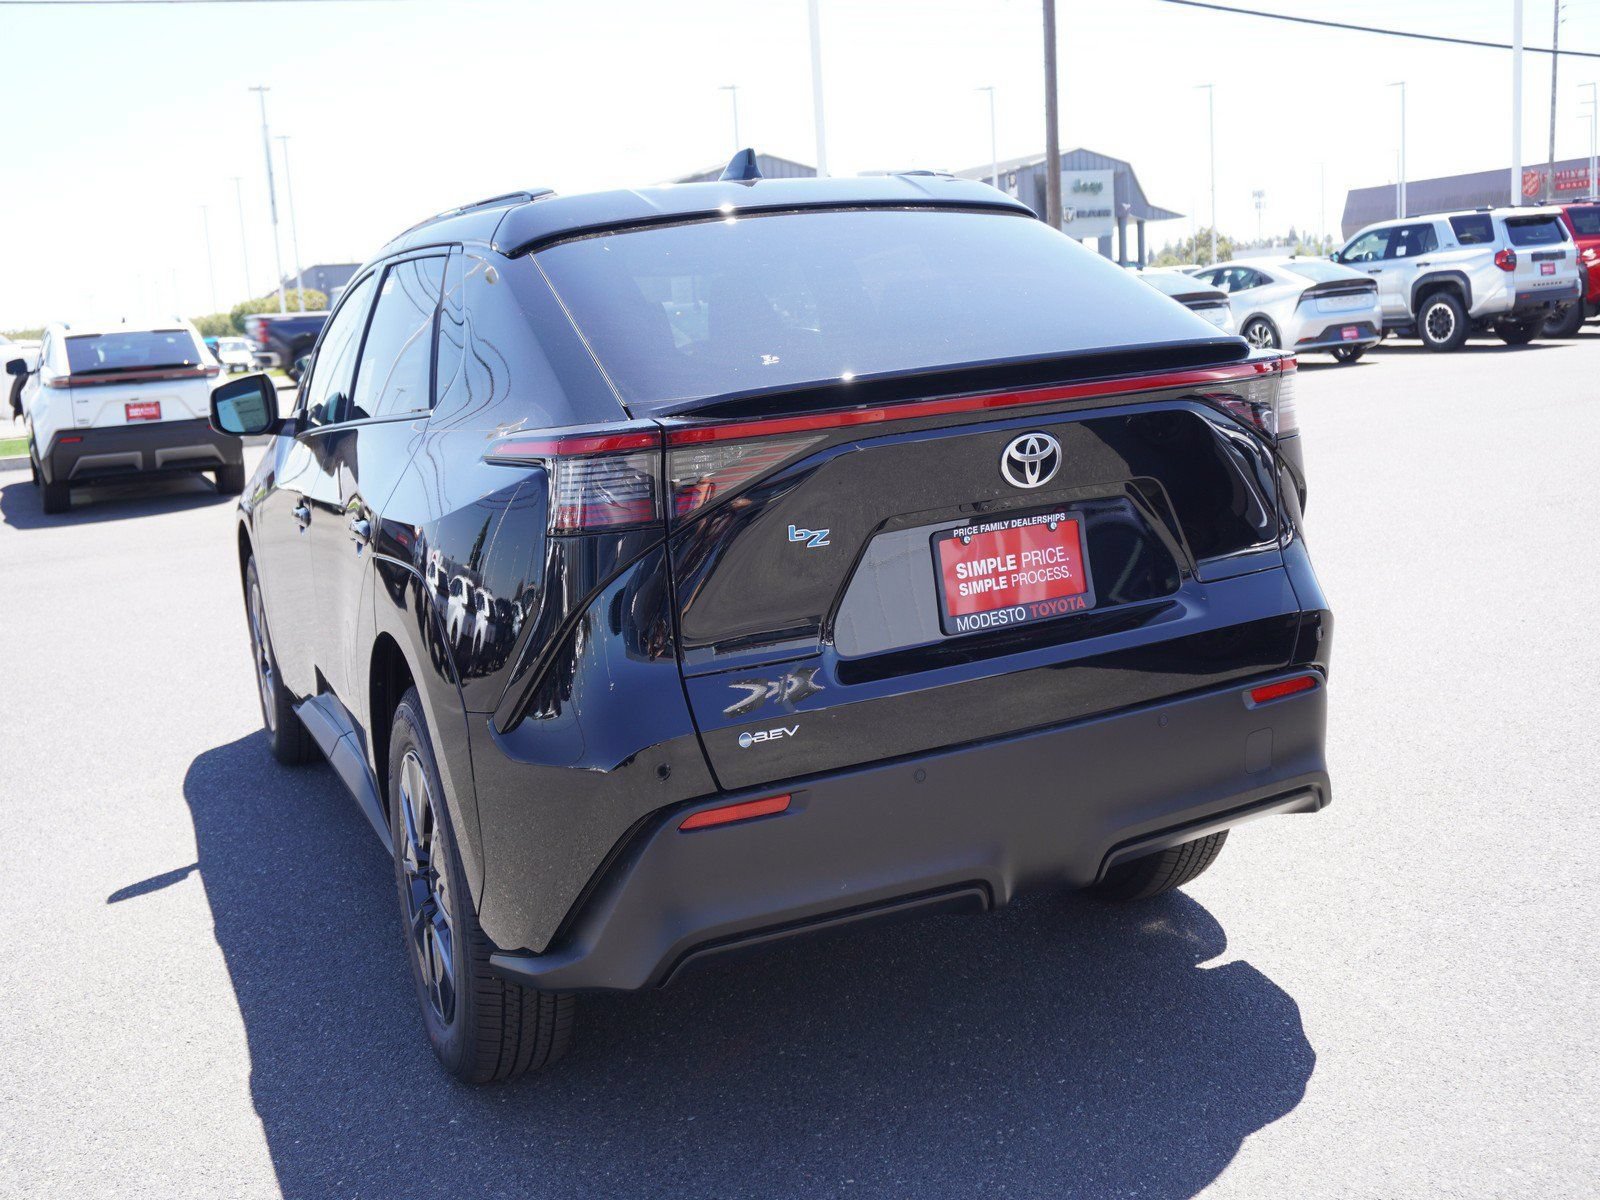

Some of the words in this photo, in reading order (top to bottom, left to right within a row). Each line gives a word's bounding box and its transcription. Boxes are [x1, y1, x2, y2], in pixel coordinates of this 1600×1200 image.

[953, 526, 979, 538] PRICE
[980, 520, 1010, 534] FAMILY
[1011, 512, 1066, 528] DEALERSHIPS
[956, 555, 1017, 579] SIMPLE
[1021, 546, 1070, 568] PRICE.
[958, 575, 1009, 597] SIMPLE
[1011, 565, 1073, 588] PROCESS.
[956, 606, 1027, 632] MODESTO
[1029, 597, 1086, 618] TOYOTA
[752, 724, 800, 743] BEV
